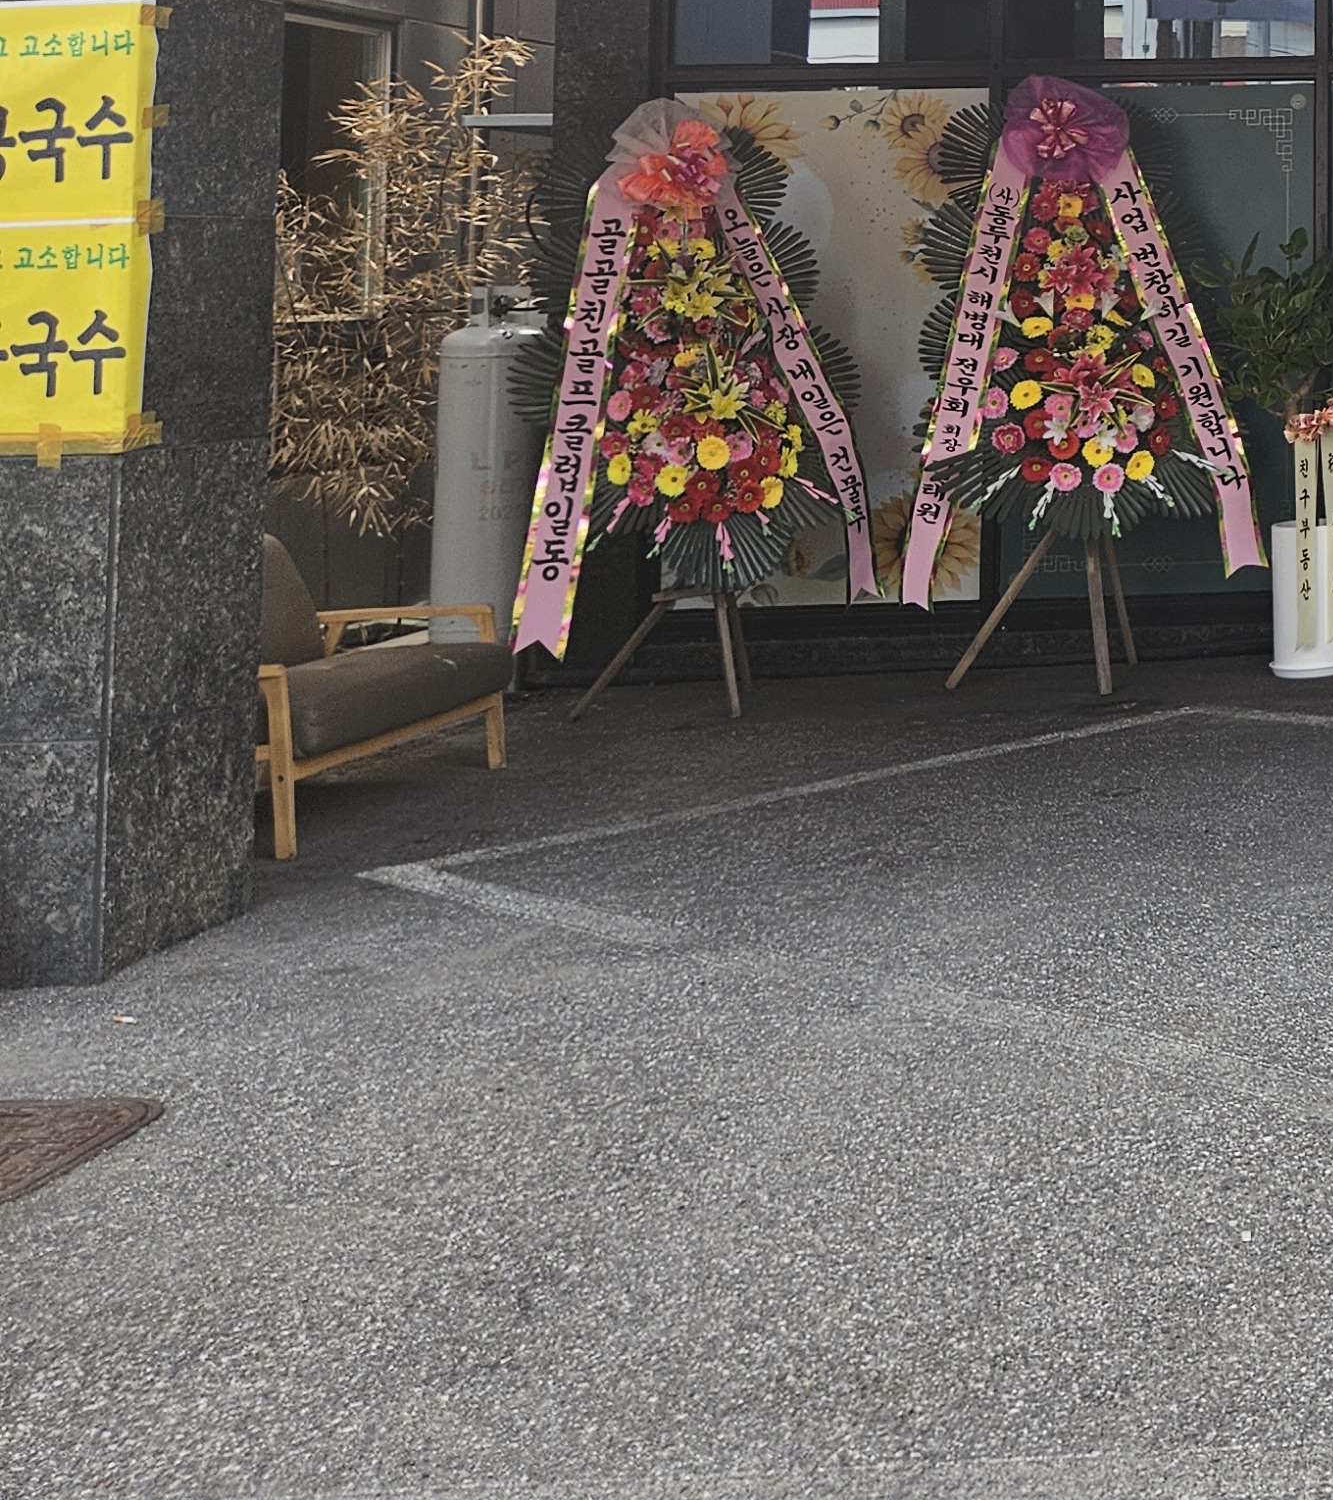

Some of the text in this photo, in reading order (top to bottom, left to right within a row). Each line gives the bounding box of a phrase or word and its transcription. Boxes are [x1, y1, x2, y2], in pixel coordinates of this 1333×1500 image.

[20, 30, 135, 56] 고소합니다
[14, 244, 129, 270] 고소합니다
[970, 183, 1022, 286] (사)동두천시
[0, 310, 127, 397] 국수
[723, 206, 772, 288] 오늘은
[766, 297, 800, 352] 사장
[787, 357, 844, 434] 내일은
[957, 289, 993, 352] 해병대
[1110, 180, 1247, 491] 사업 번창하길 기원합니다
[531, 217, 626, 583] 골골친골프클럽일동
[942, 355, 979, 420] 전우회
[939, 422, 963, 452] 회장
[1299, 458, 1312, 601] 친구부동산
